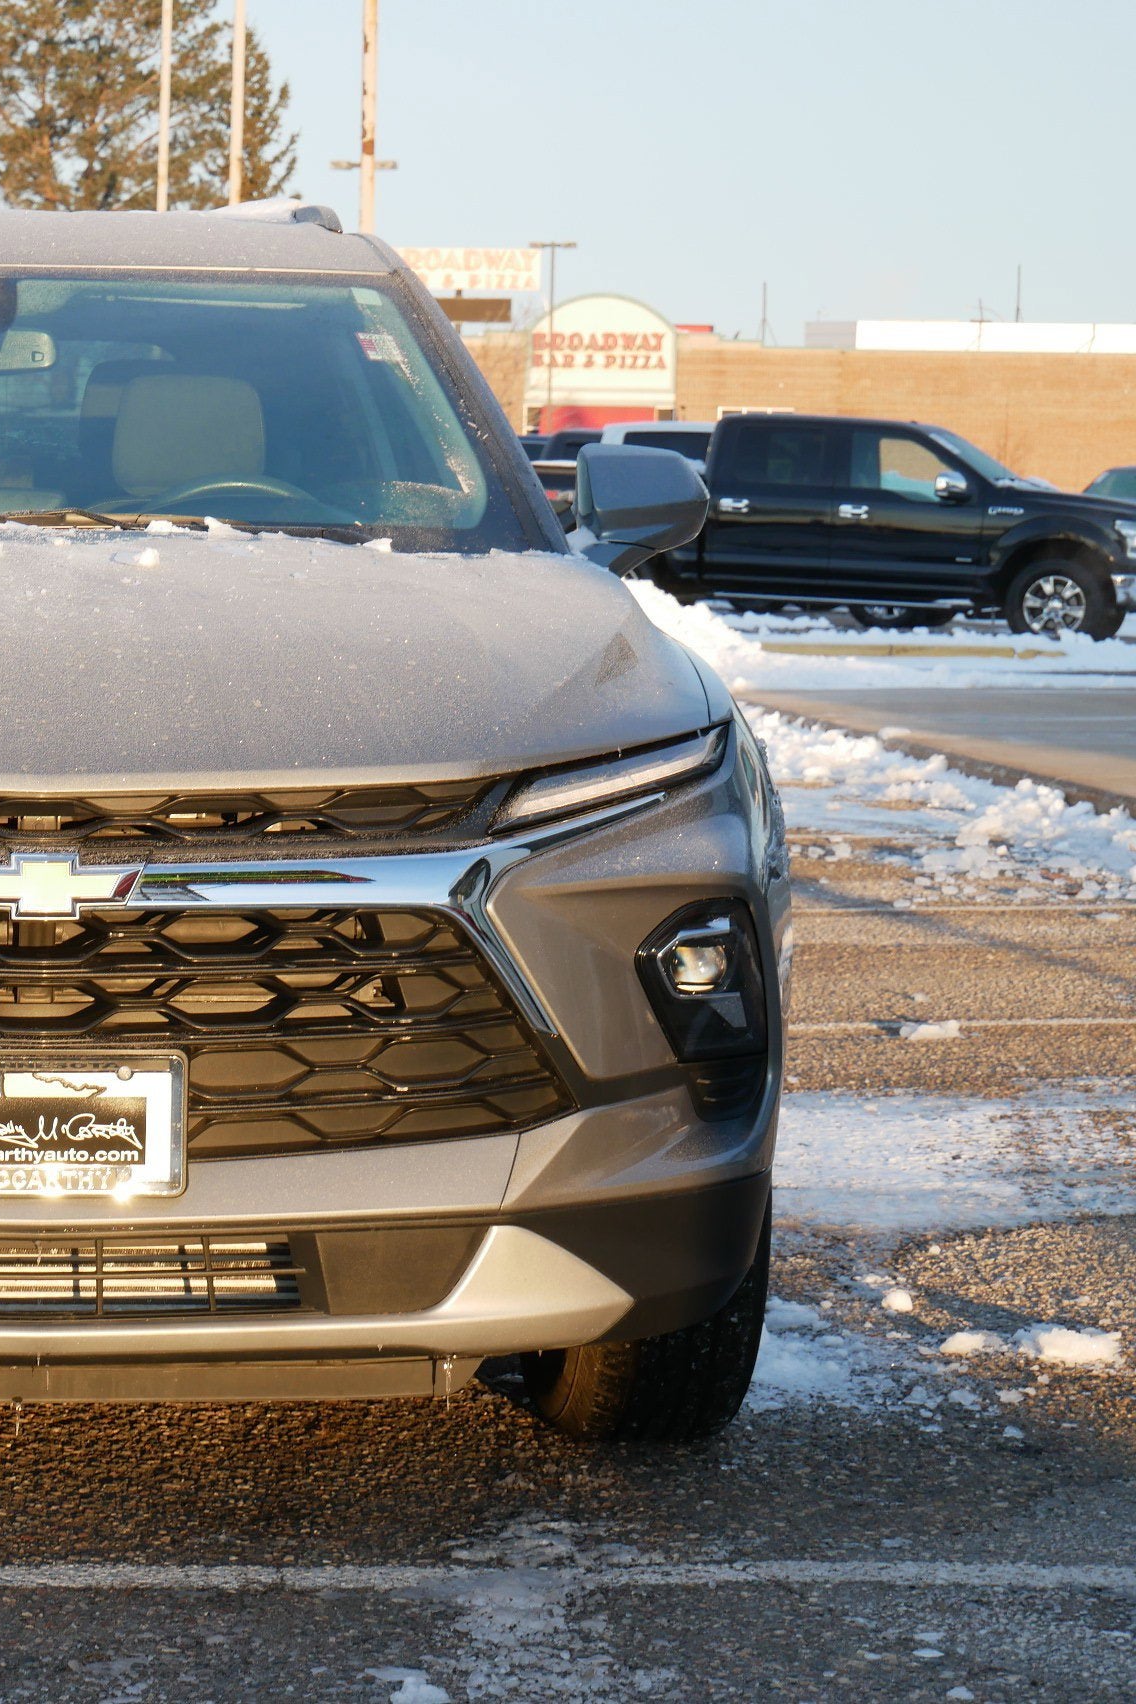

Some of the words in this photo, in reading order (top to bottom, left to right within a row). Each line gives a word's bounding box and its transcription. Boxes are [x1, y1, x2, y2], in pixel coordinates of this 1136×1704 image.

[531, 332, 665, 352] BROADWAY
[532, 353, 575, 368] BAR
[604, 354, 667, 370] PIZZA
